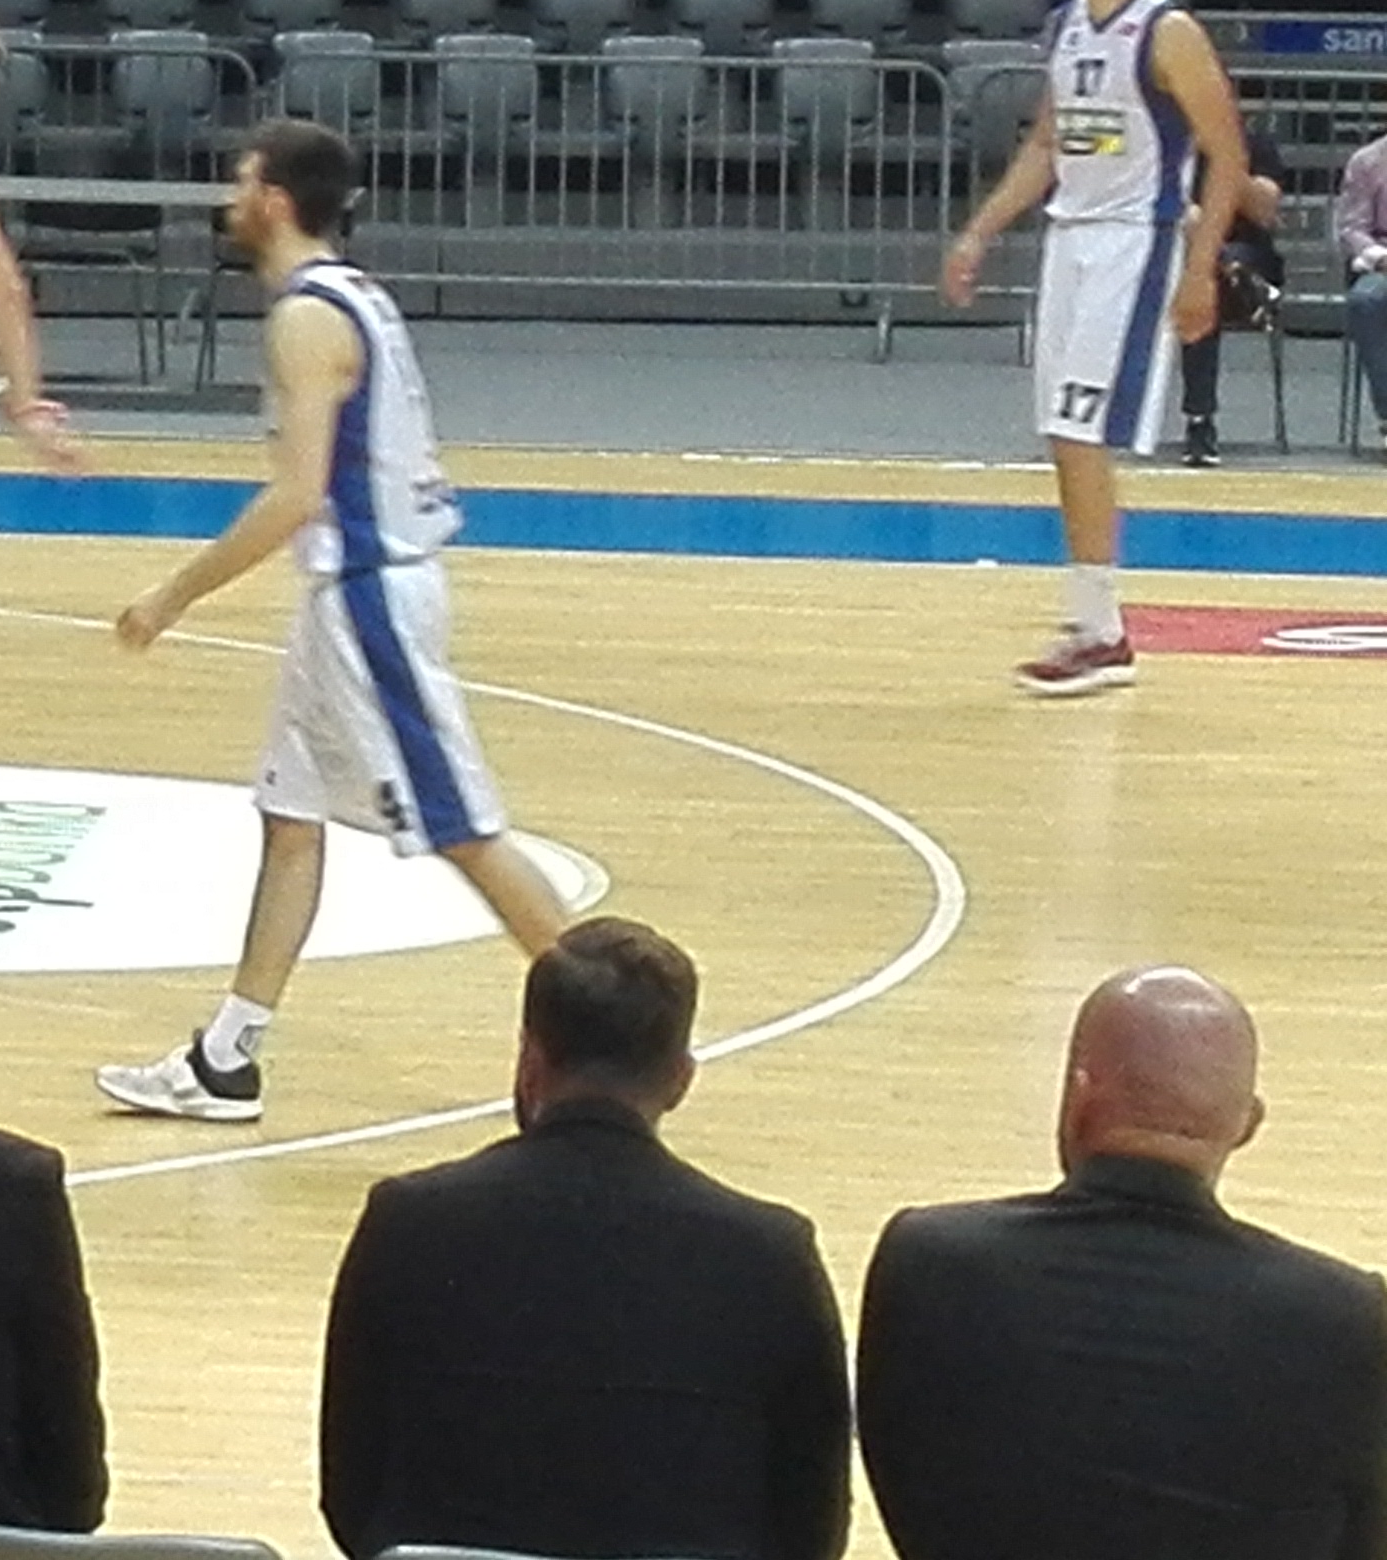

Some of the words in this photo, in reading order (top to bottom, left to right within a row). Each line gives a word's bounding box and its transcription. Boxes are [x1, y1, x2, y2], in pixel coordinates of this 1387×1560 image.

[1323, 27, 1387, 53] san
[1074, 57, 1106, 98] 17
[1059, 381, 1110, 424] 17
